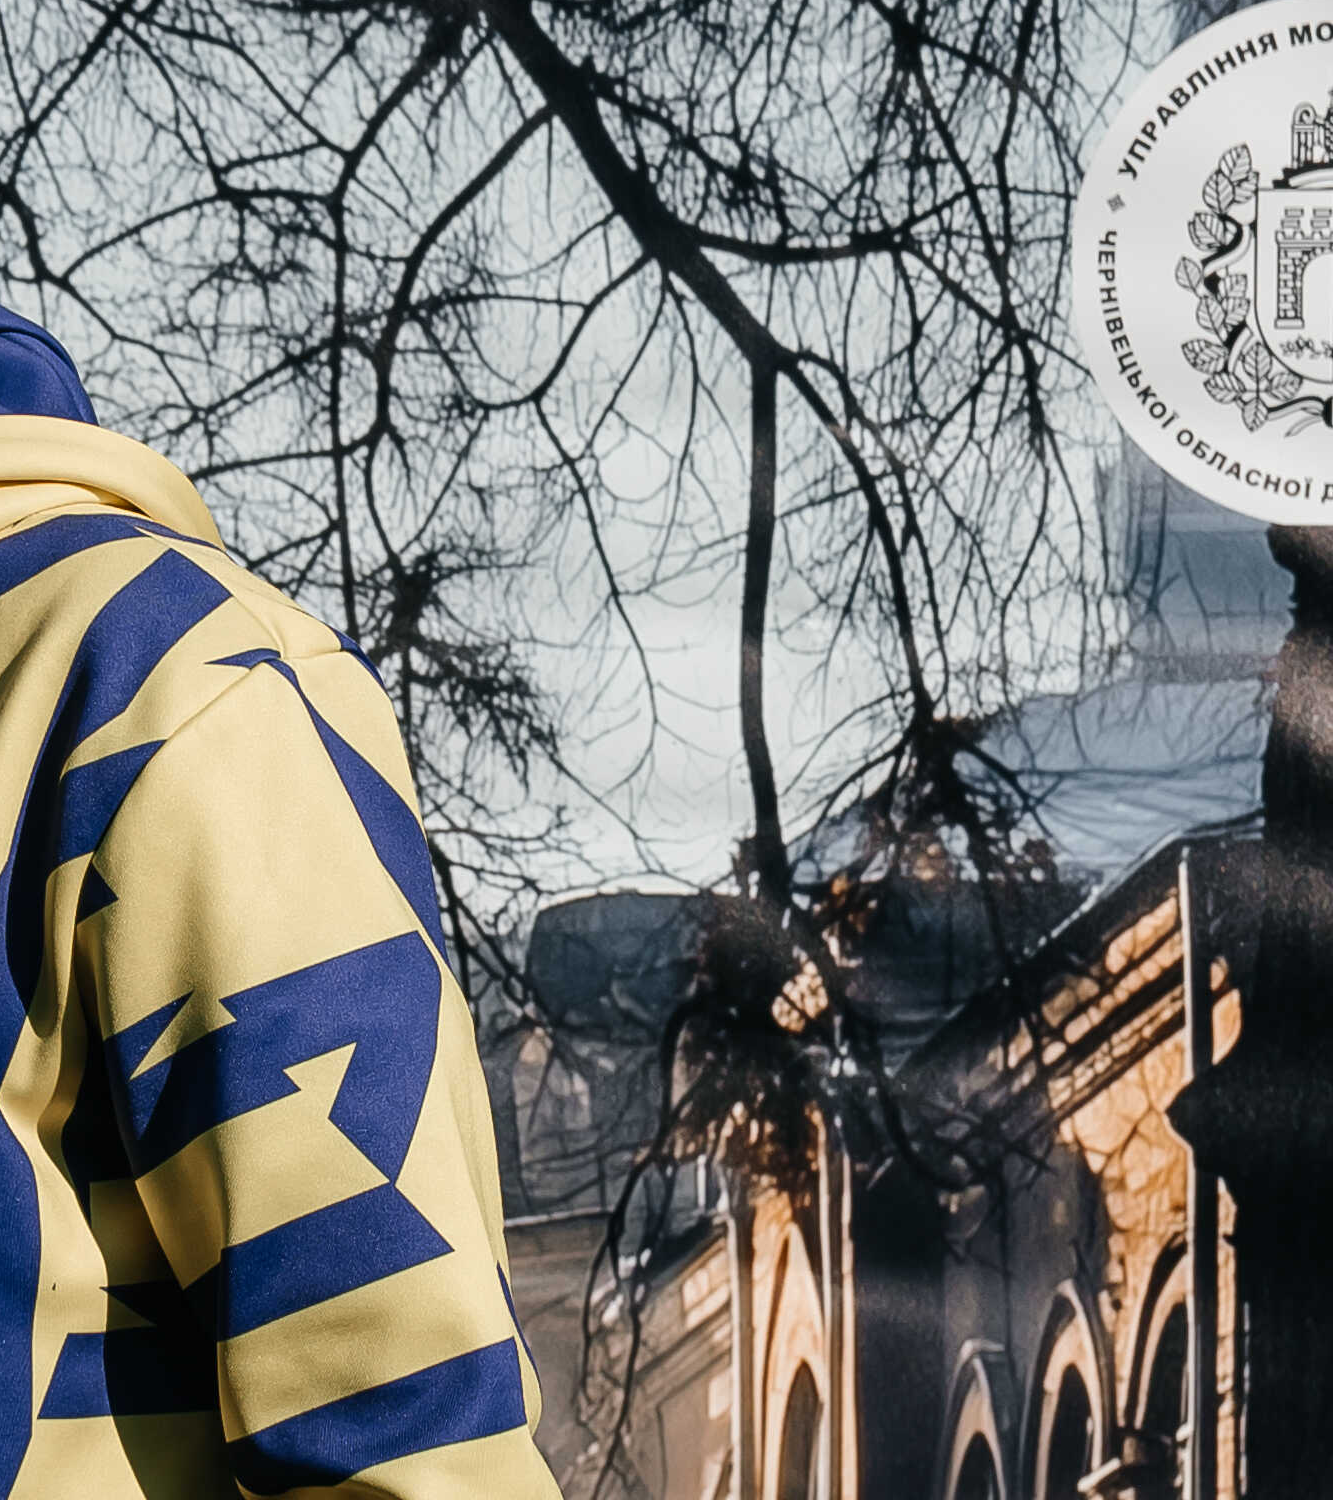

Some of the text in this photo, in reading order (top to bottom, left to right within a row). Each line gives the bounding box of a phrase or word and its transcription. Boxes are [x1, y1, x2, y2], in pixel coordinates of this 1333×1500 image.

[1117, 31, 1279, 180] УПРАВЛІННЯ
[1097, 230, 1179, 429] ЧЕРНІВЕЦЬКОЇ
[1176, 429, 1312, 499] ОБЛАСНОЇ
